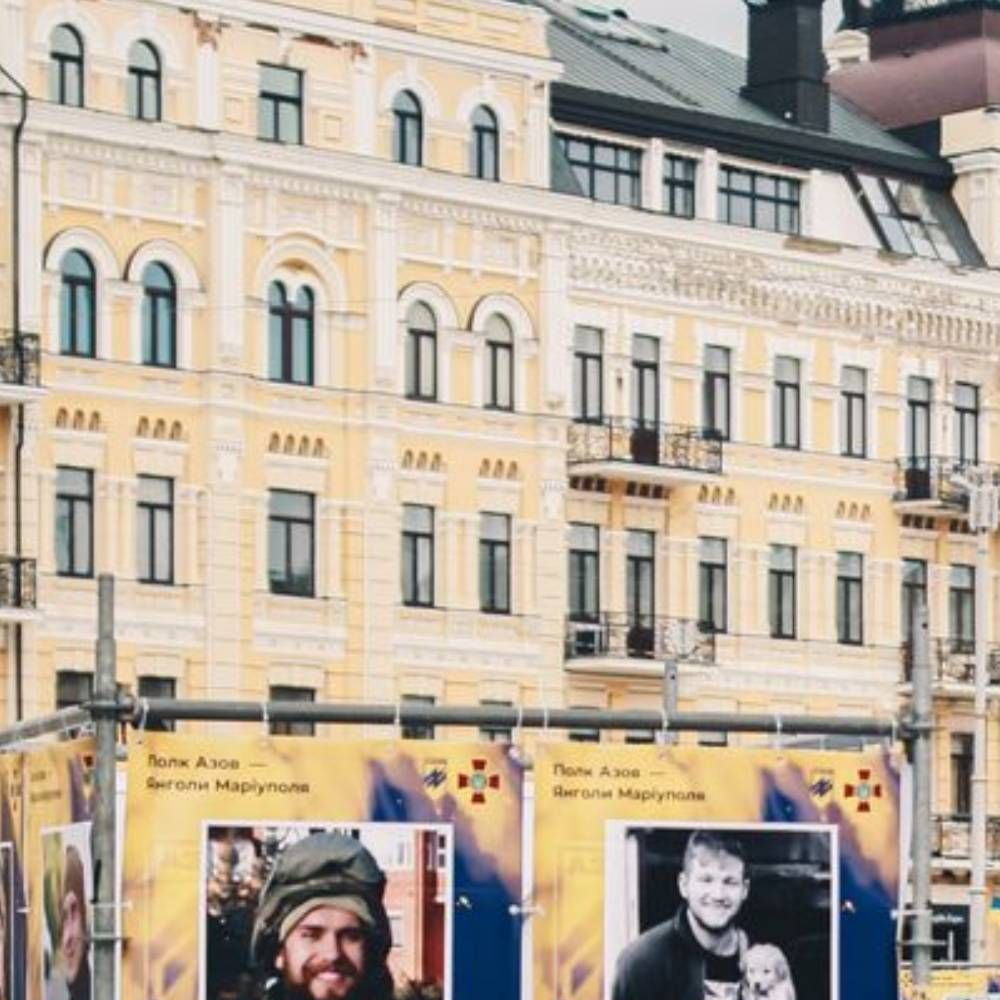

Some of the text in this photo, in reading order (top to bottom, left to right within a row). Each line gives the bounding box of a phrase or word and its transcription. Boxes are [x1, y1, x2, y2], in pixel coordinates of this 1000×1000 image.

[148, 753, 191, 770] Полк
[196, 755, 241, 770] Азов
[553, 763, 593, 779] Полк
[600, 764, 642, 779] Азов
[146, 776, 311, 796] Янголи Маріуполя
[552, 785, 706, 803] Янголи Маріуполя
